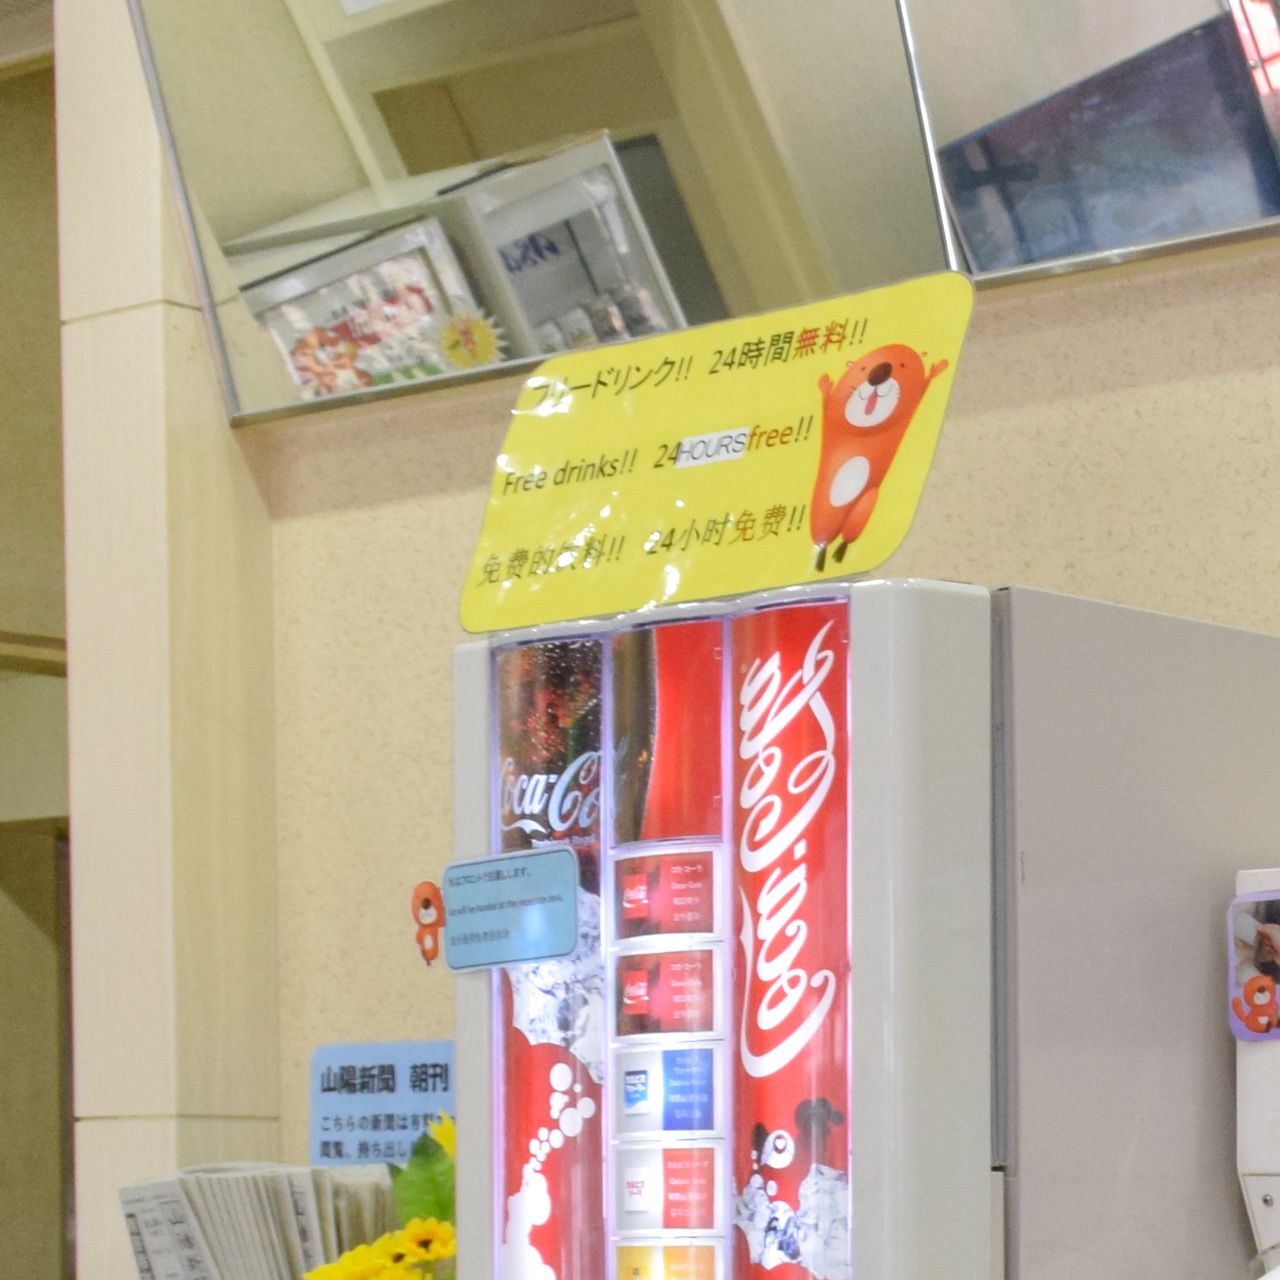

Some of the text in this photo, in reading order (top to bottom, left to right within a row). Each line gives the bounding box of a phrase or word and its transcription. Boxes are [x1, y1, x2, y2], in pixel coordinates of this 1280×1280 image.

[708, 318, 869, 376] 24時間無料!!
[502, 467, 548, 497] Free
[553, 448, 639, 487] drinks!!
[738, 619, 836, 1079] Coca-Cola
[320, 1062, 449, 1095] 山陽新聞 朝刊
